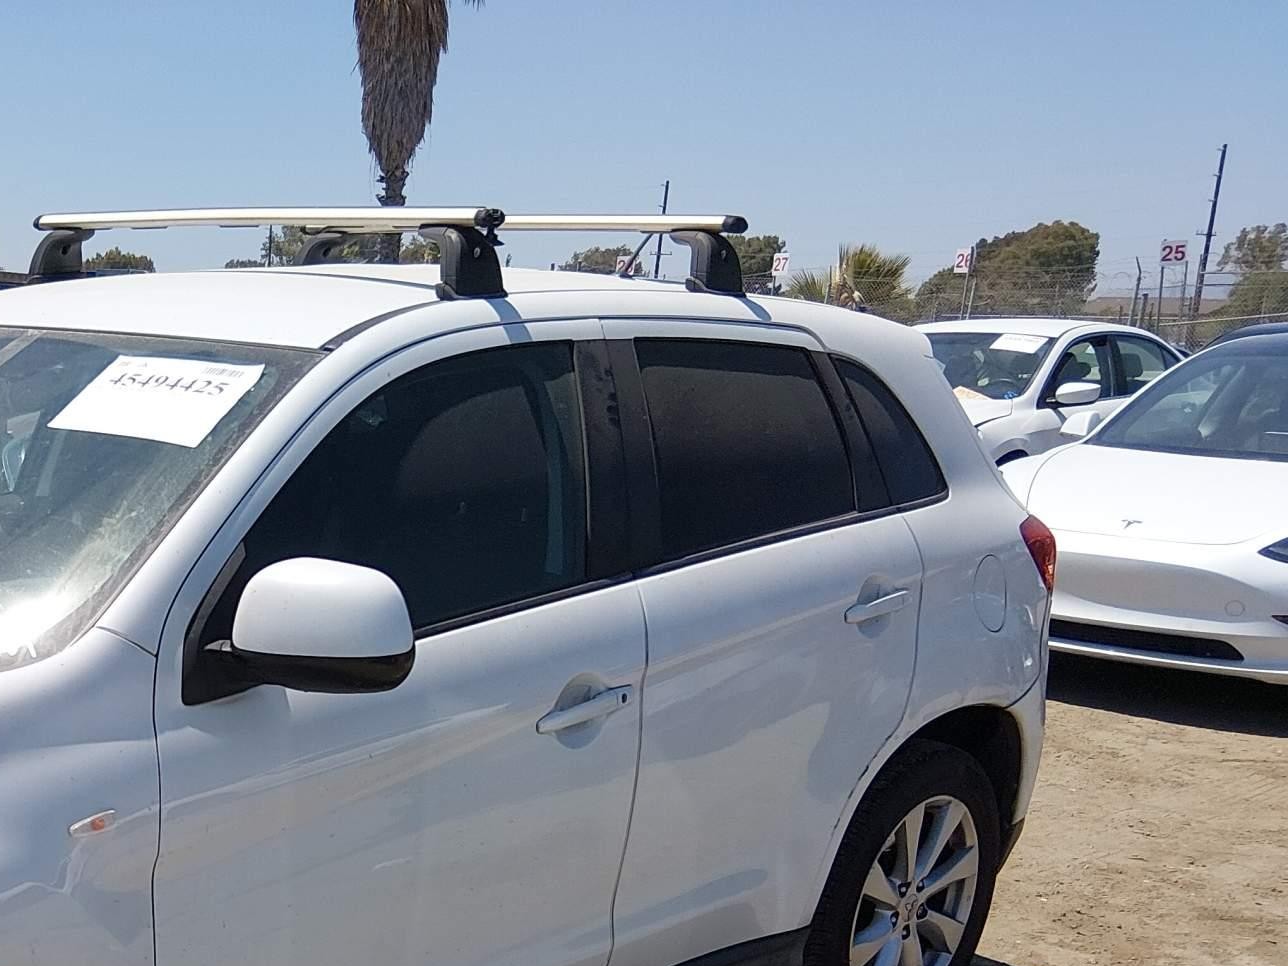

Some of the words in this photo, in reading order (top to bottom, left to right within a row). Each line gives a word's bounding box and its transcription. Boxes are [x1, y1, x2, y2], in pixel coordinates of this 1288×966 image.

[1161, 244, 1187, 262] 25
[773, 256, 789, 272] 27
[109, 372, 230, 395] 45494425
